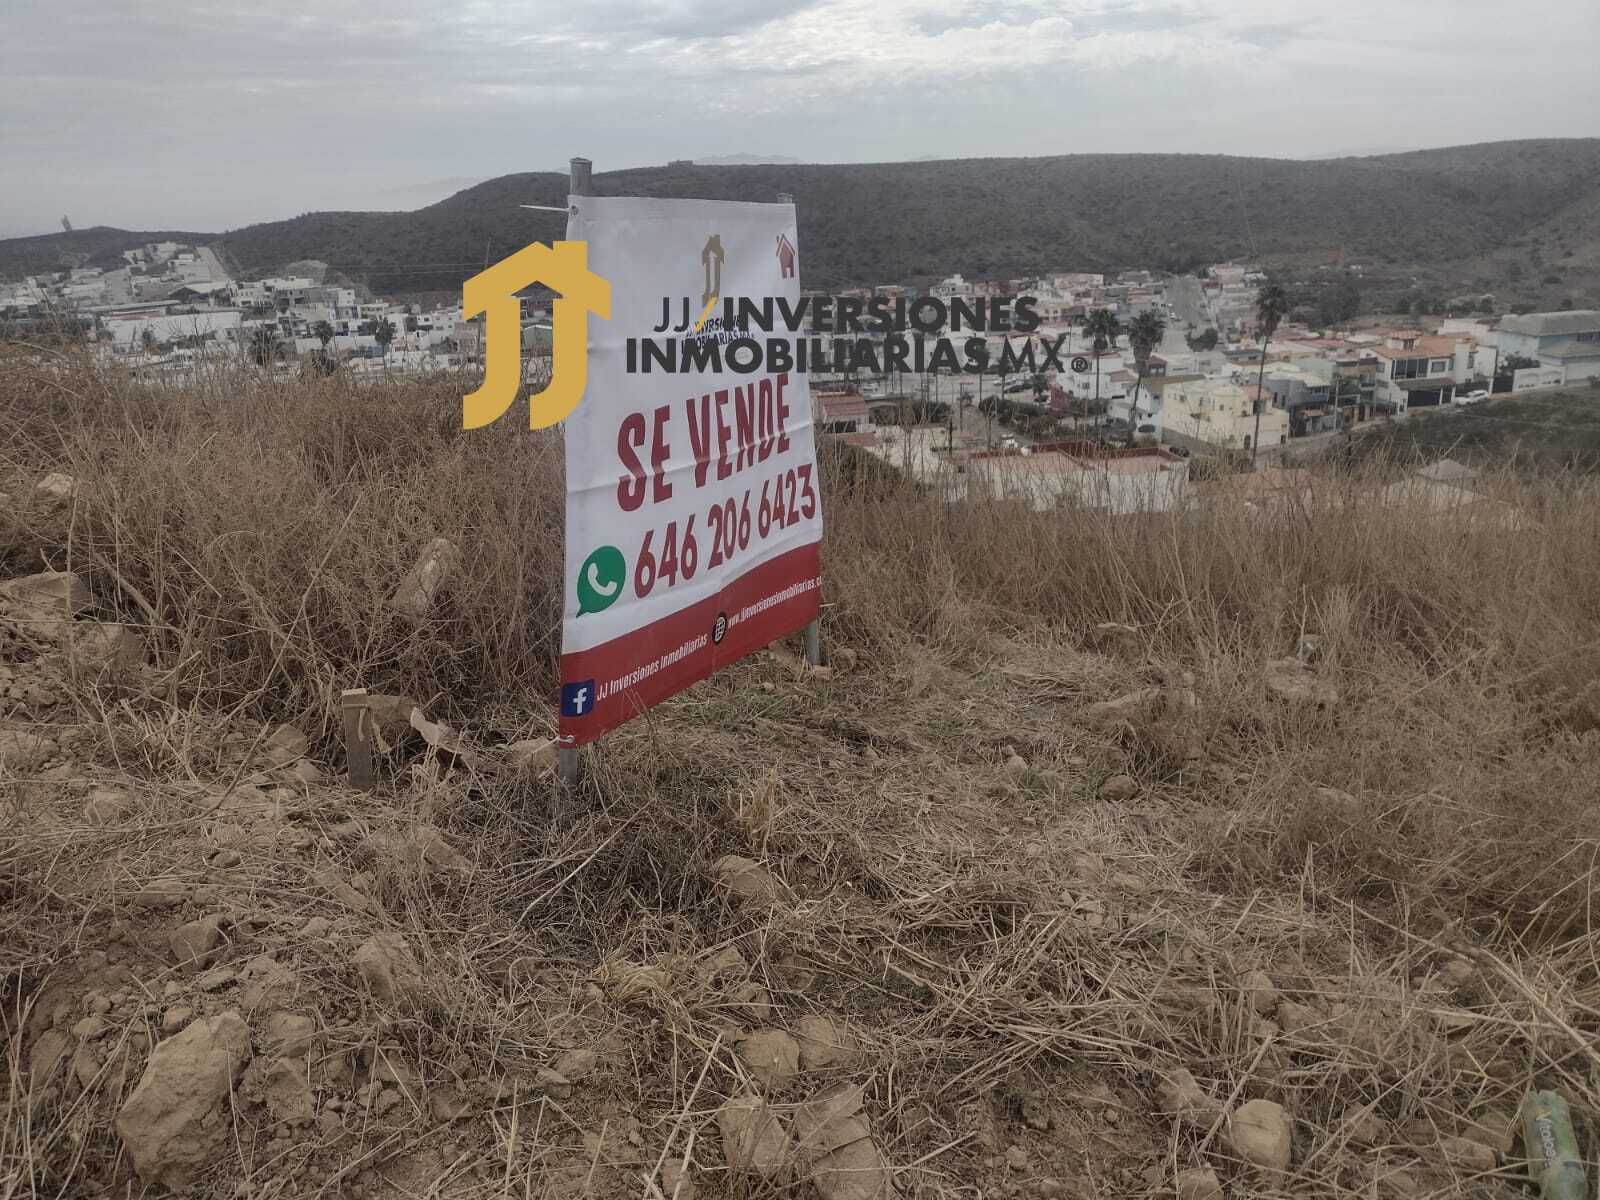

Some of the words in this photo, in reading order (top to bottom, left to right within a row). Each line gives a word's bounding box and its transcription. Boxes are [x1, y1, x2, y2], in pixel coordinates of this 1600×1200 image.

[617, 405, 673, 512] SE
[686, 373, 790, 489] VENDE
[634, 513, 698, 599] 646
[707, 490, 751, 570] 206
[758, 463, 816, 538] 6423
[596, 682, 609, 701] JJ
[610, 658, 660, 695] Inversiones
[660, 633, 708, 669] Inmobiliarias
